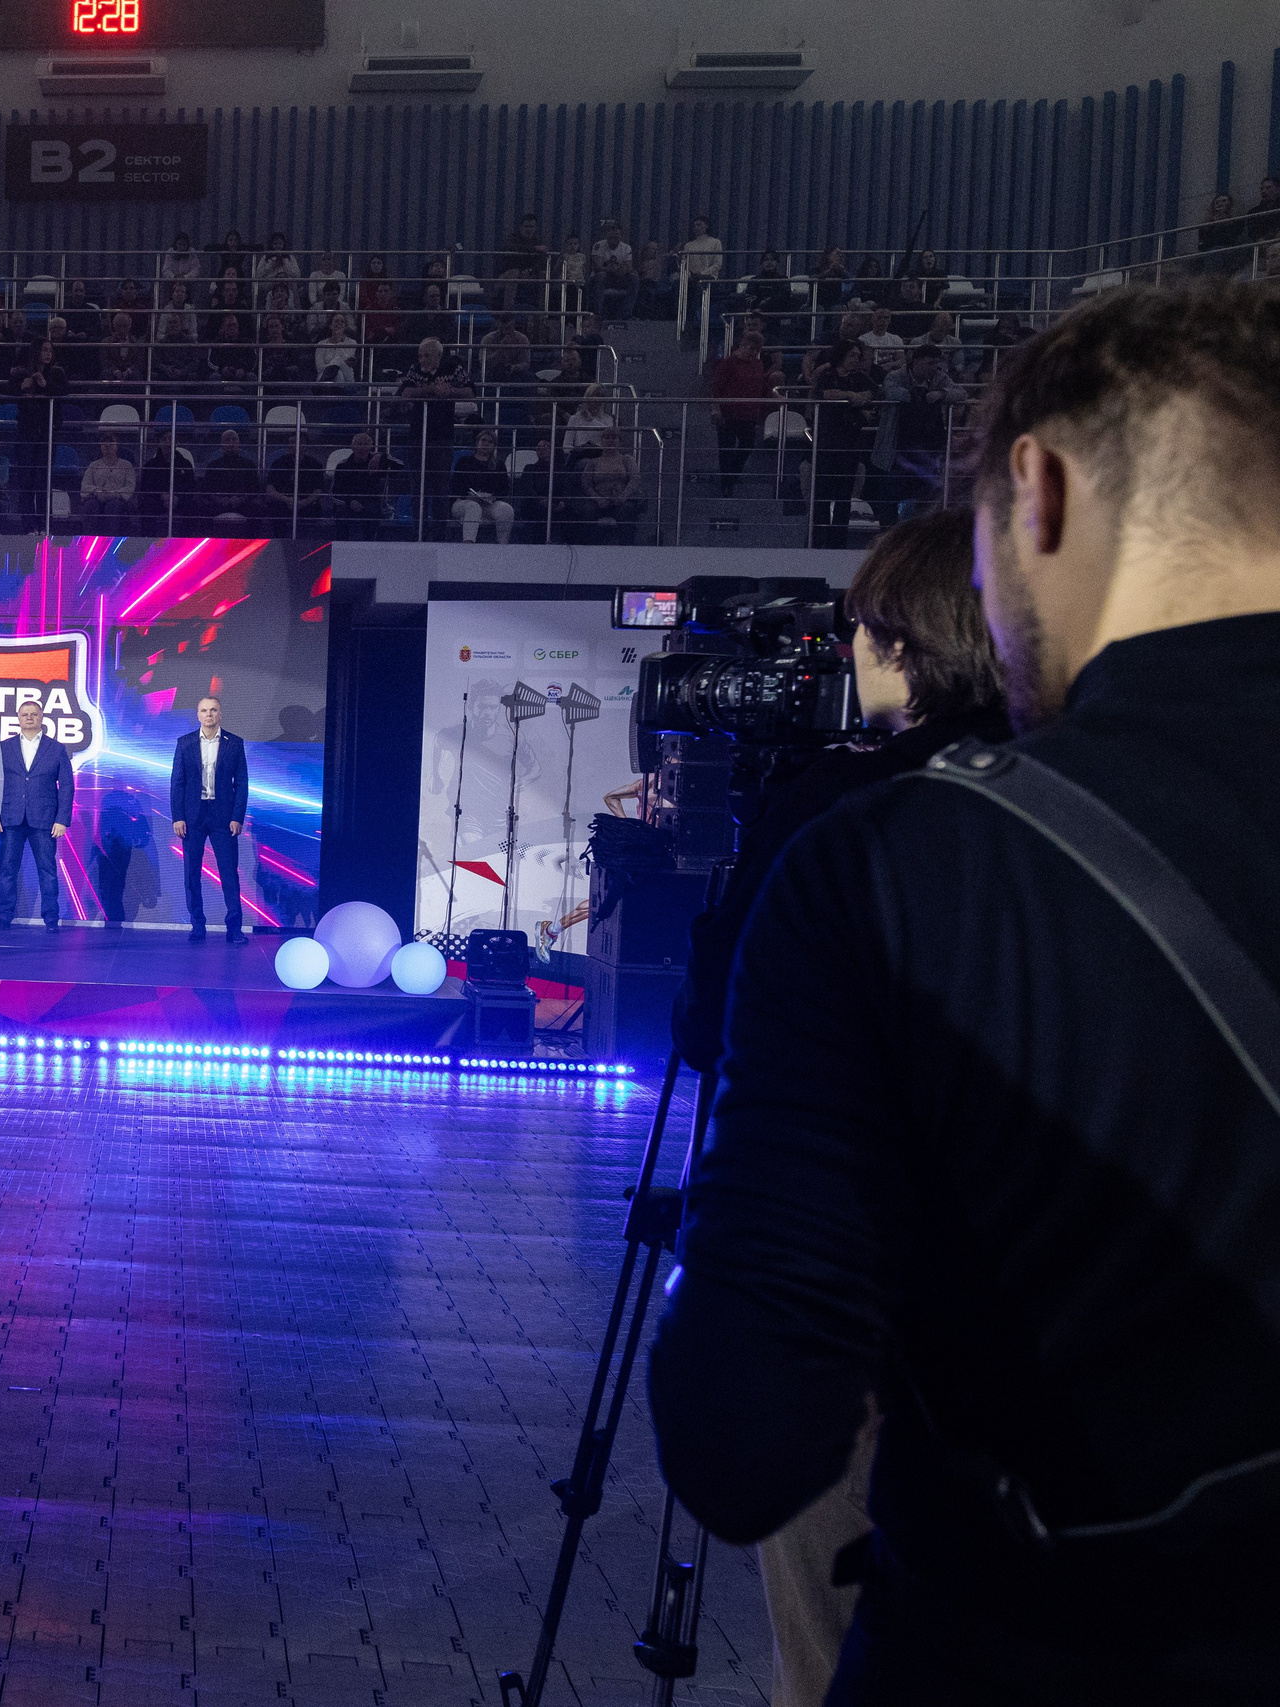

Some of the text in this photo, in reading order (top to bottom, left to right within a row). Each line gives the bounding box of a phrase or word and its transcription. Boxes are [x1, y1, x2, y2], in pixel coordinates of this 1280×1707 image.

[30, 139, 117, 183] B2
[124, 155, 182, 166] СЕКТОР
[124, 172, 180, 183] SECTOR
[549, 650, 579, 659] СБЕР
